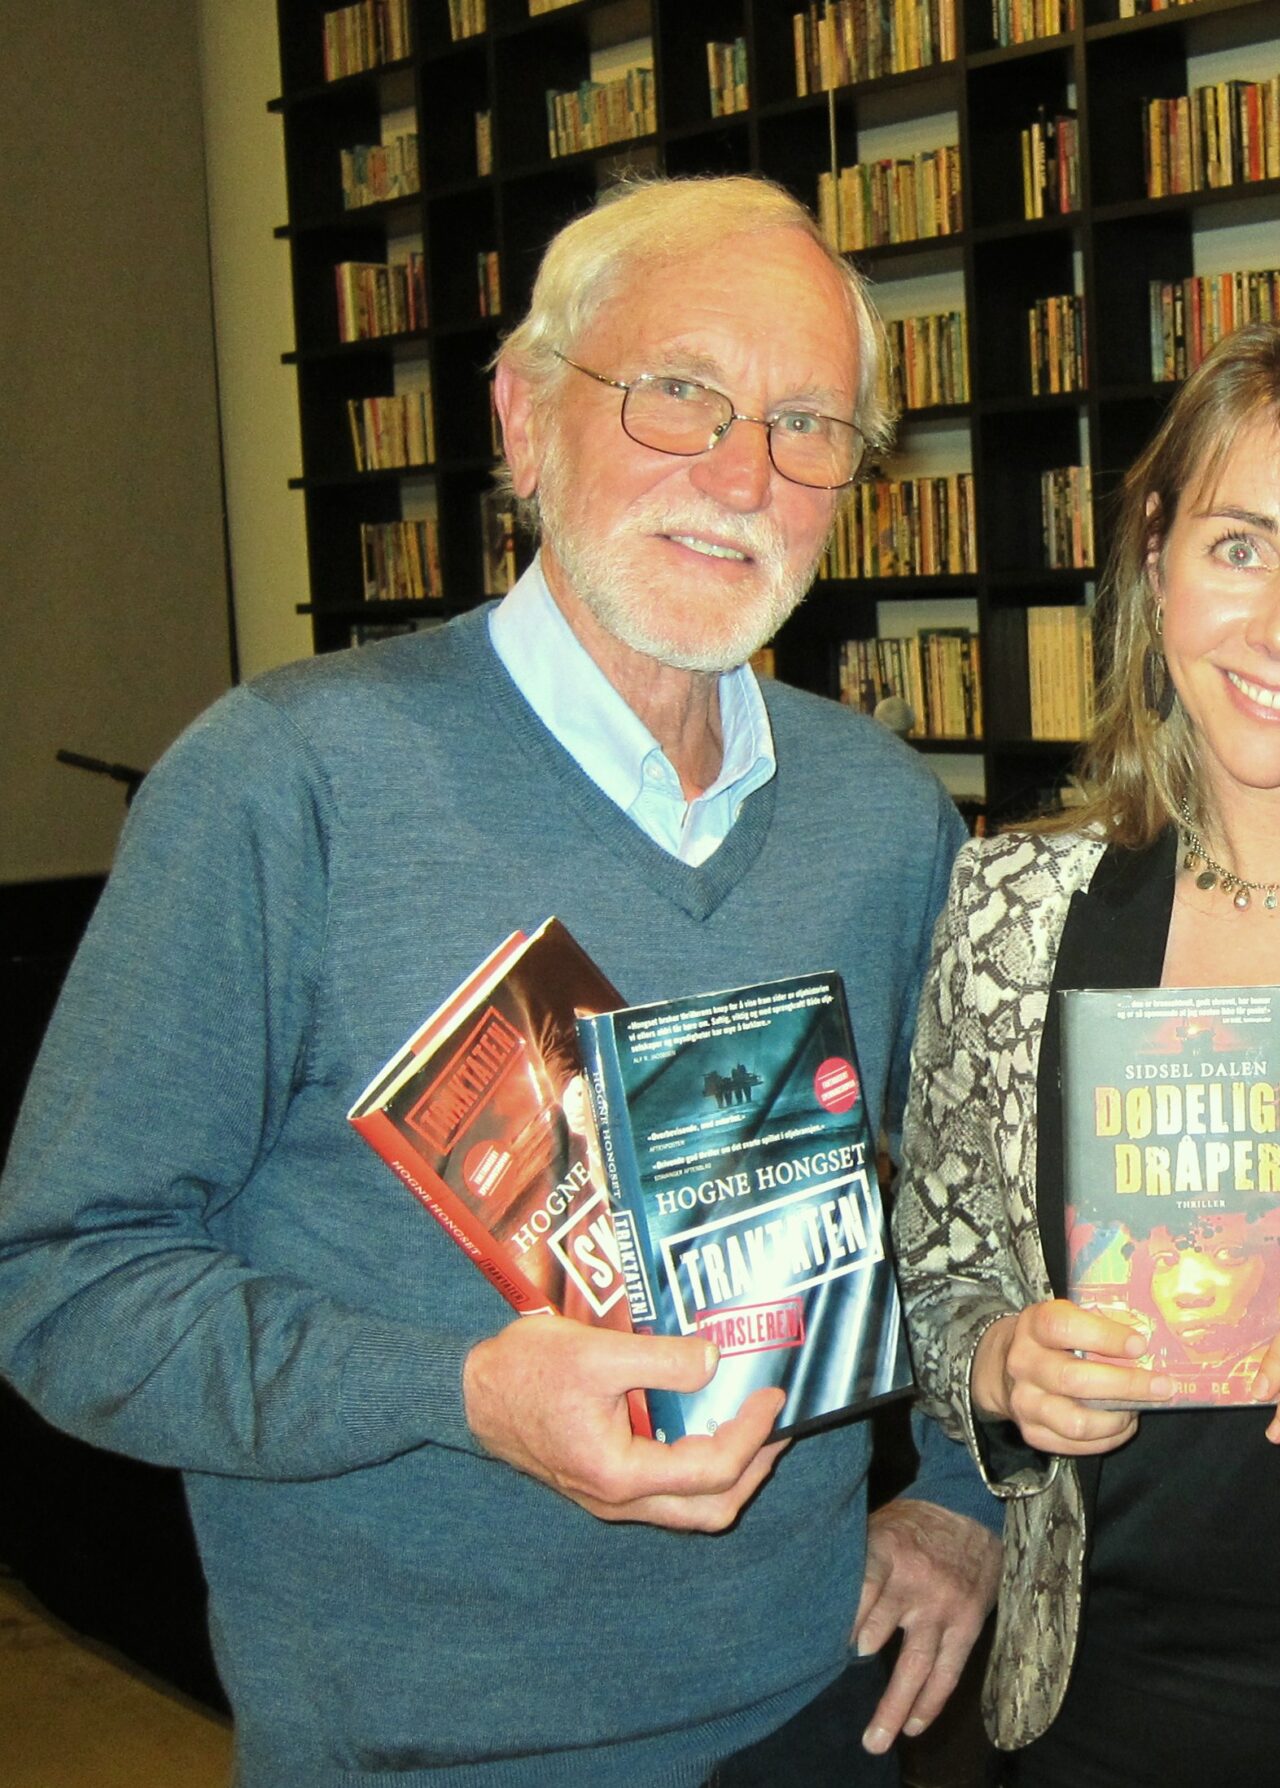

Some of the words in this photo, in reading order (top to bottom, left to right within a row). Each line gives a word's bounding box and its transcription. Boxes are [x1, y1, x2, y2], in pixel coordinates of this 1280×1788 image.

[420, 1021, 517, 1143] TRAKTATEN
[1125, 1063, 1193, 1080] SIDSEL
[1200, 1061, 1267, 1077] DALEN
[391, 1159, 433, 1203] HOGNE
[430, 1200, 482, 1258] HONGSET
[511, 1161, 592, 1254] HOGNE
[601, 1126, 622, 1199] HONGSET
[656, 1172, 752, 1216] HOGNE
[755, 1142, 866, 1191] HONGSET
[1176, 1200, 1226, 1209] THRILLER
[615, 1214, 647, 1323] TRAKTATEN
[679, 1192, 868, 1311] TRAKTATEN
